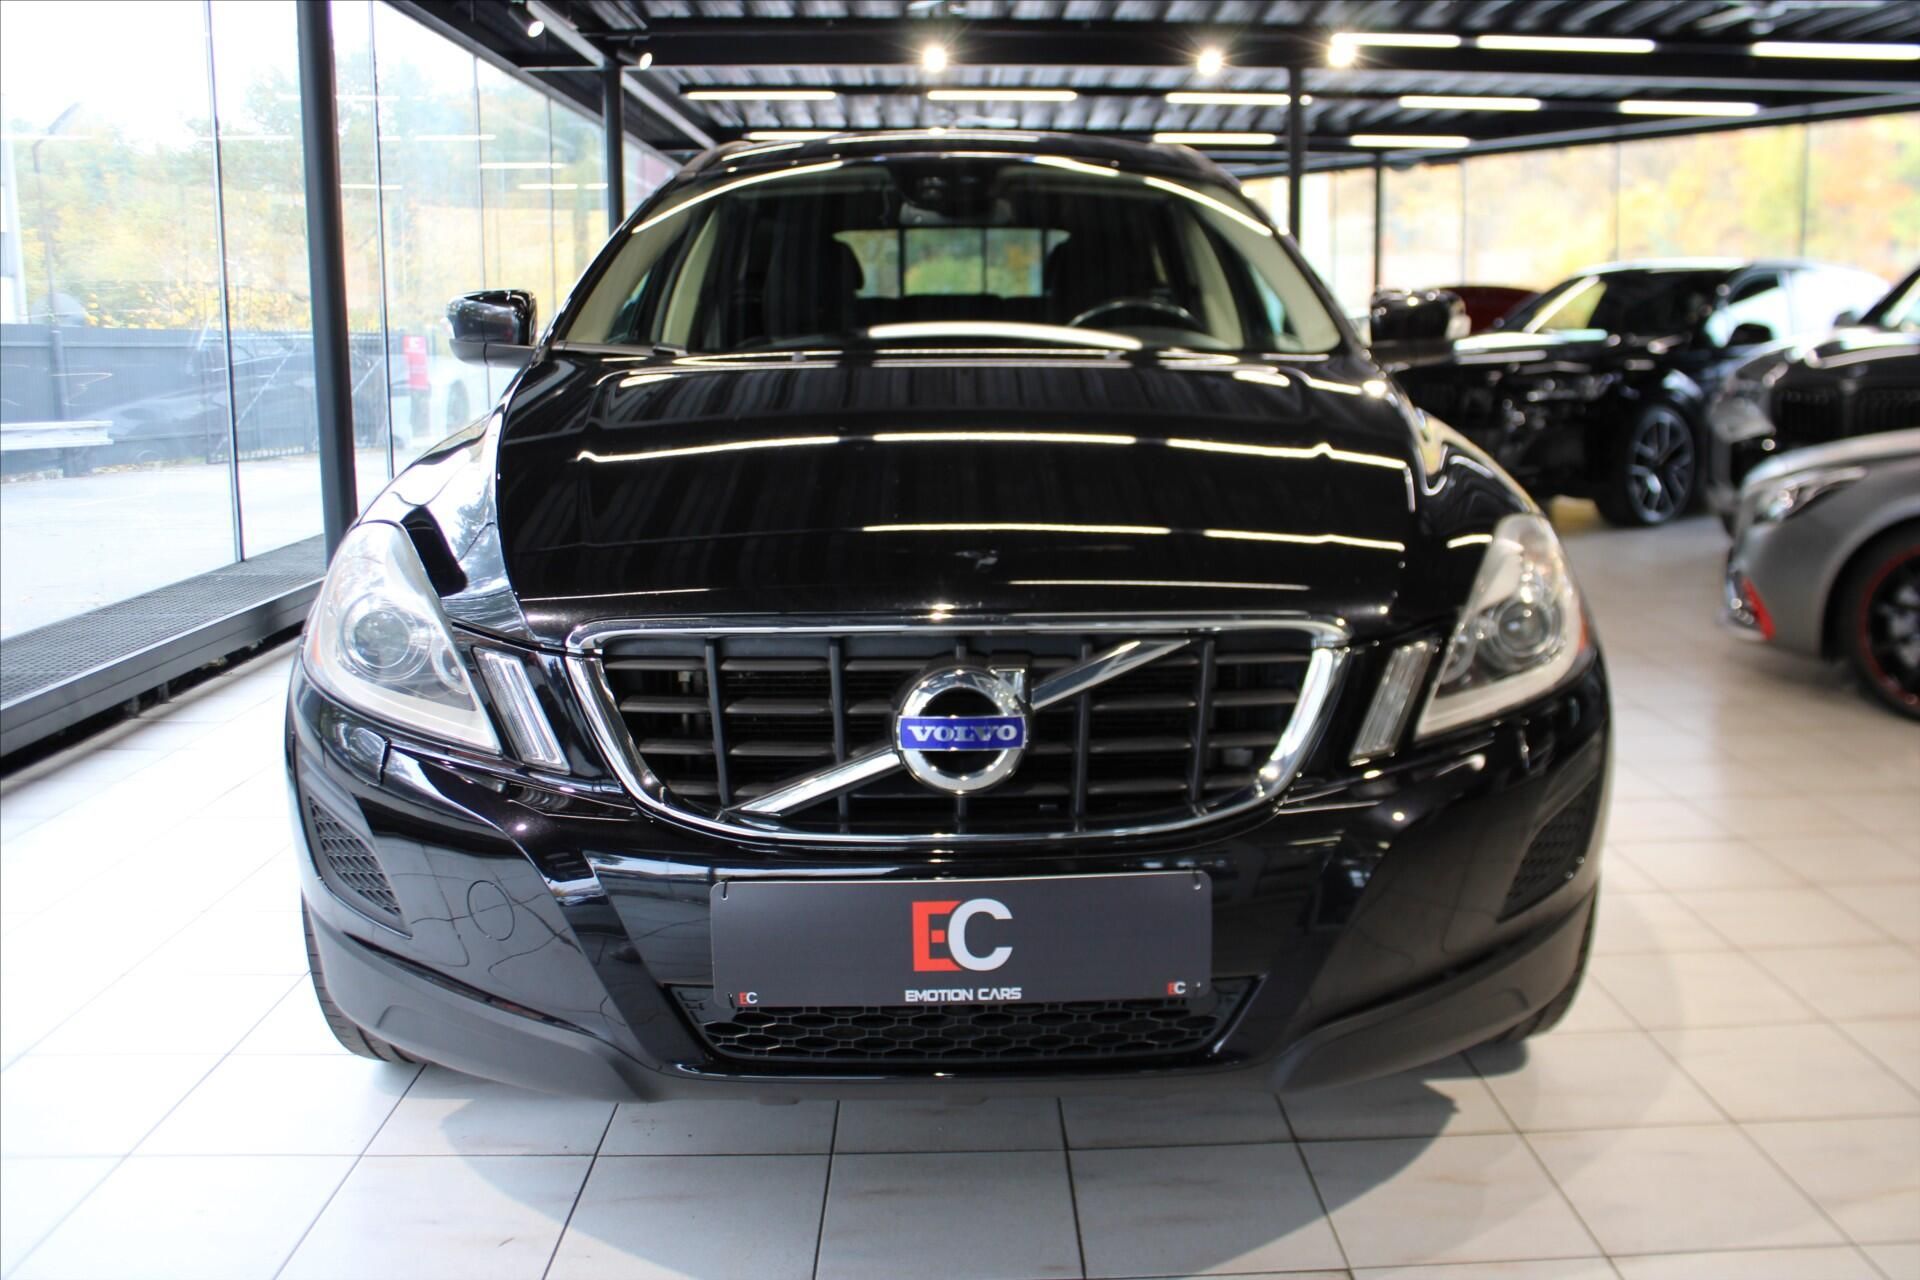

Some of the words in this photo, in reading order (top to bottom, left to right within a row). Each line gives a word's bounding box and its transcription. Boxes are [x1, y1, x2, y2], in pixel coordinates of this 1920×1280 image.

[907, 724, 1017, 742] VOLVO
[912, 898, 1013, 971] EC
[738, 991, 758, 1005] EC
[904, 988, 974, 1002] EMOTION
[977, 987, 1022, 1001] CARS
